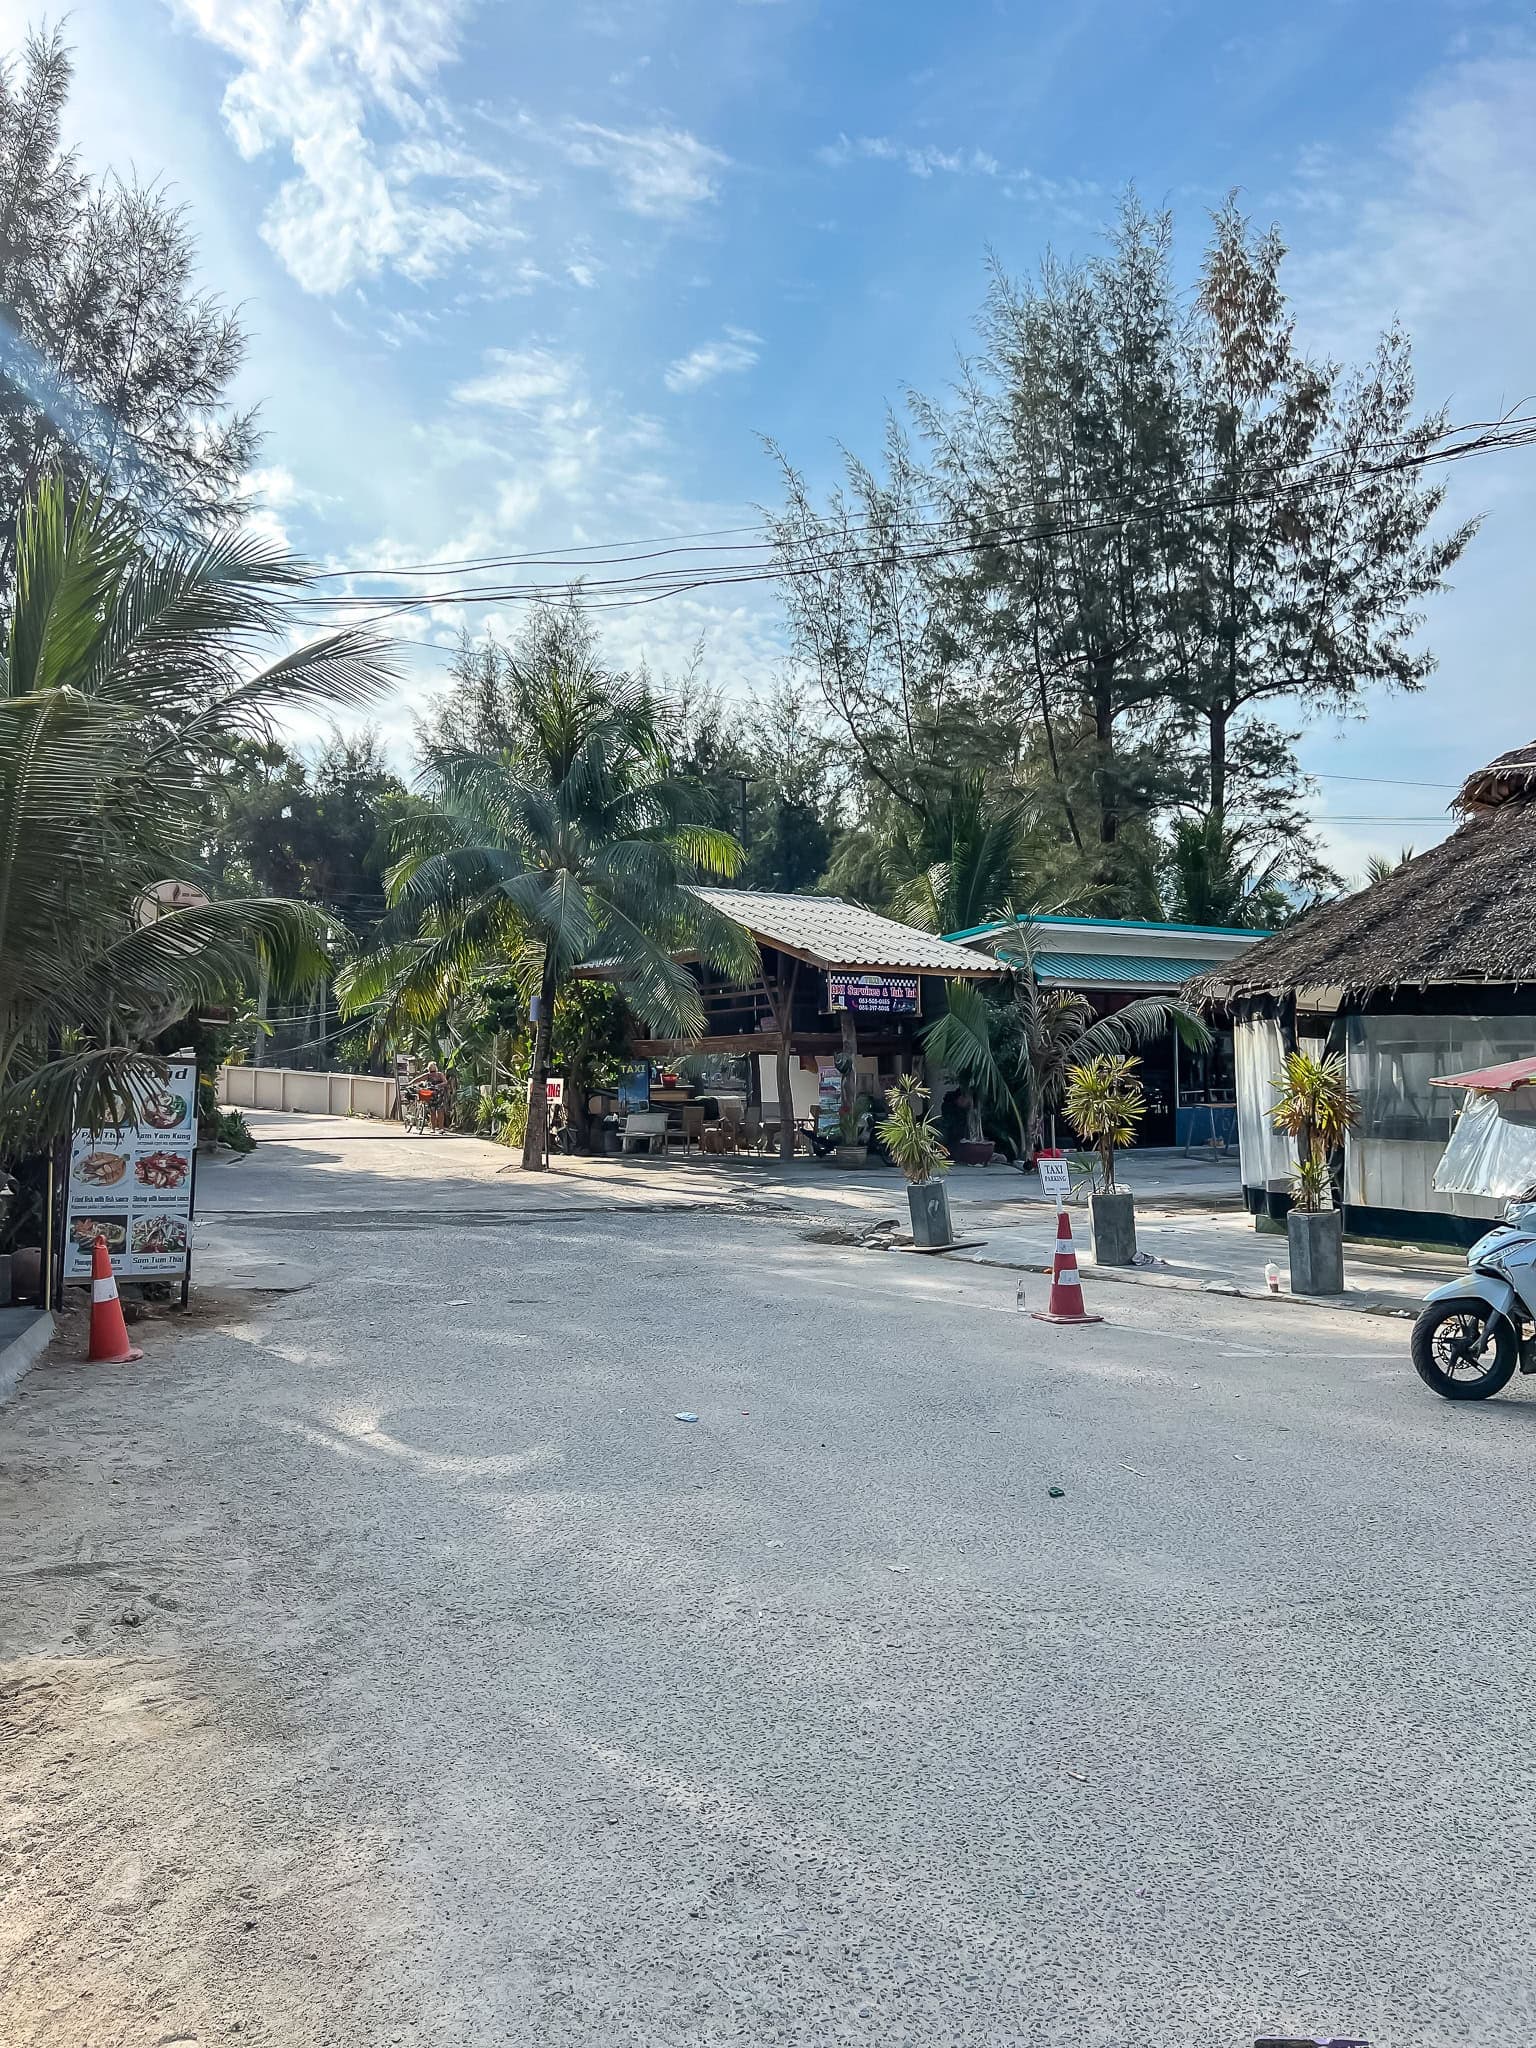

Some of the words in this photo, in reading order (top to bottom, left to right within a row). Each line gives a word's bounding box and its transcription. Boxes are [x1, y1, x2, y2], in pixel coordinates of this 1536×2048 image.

[847, 984, 880, 997] Services
[890, 986, 904, 998] Tuk
[620, 1064, 646, 1074] TAXI
[172, 1132, 191, 1142] Kung
[1044, 1164, 1064, 1175] TAXI
